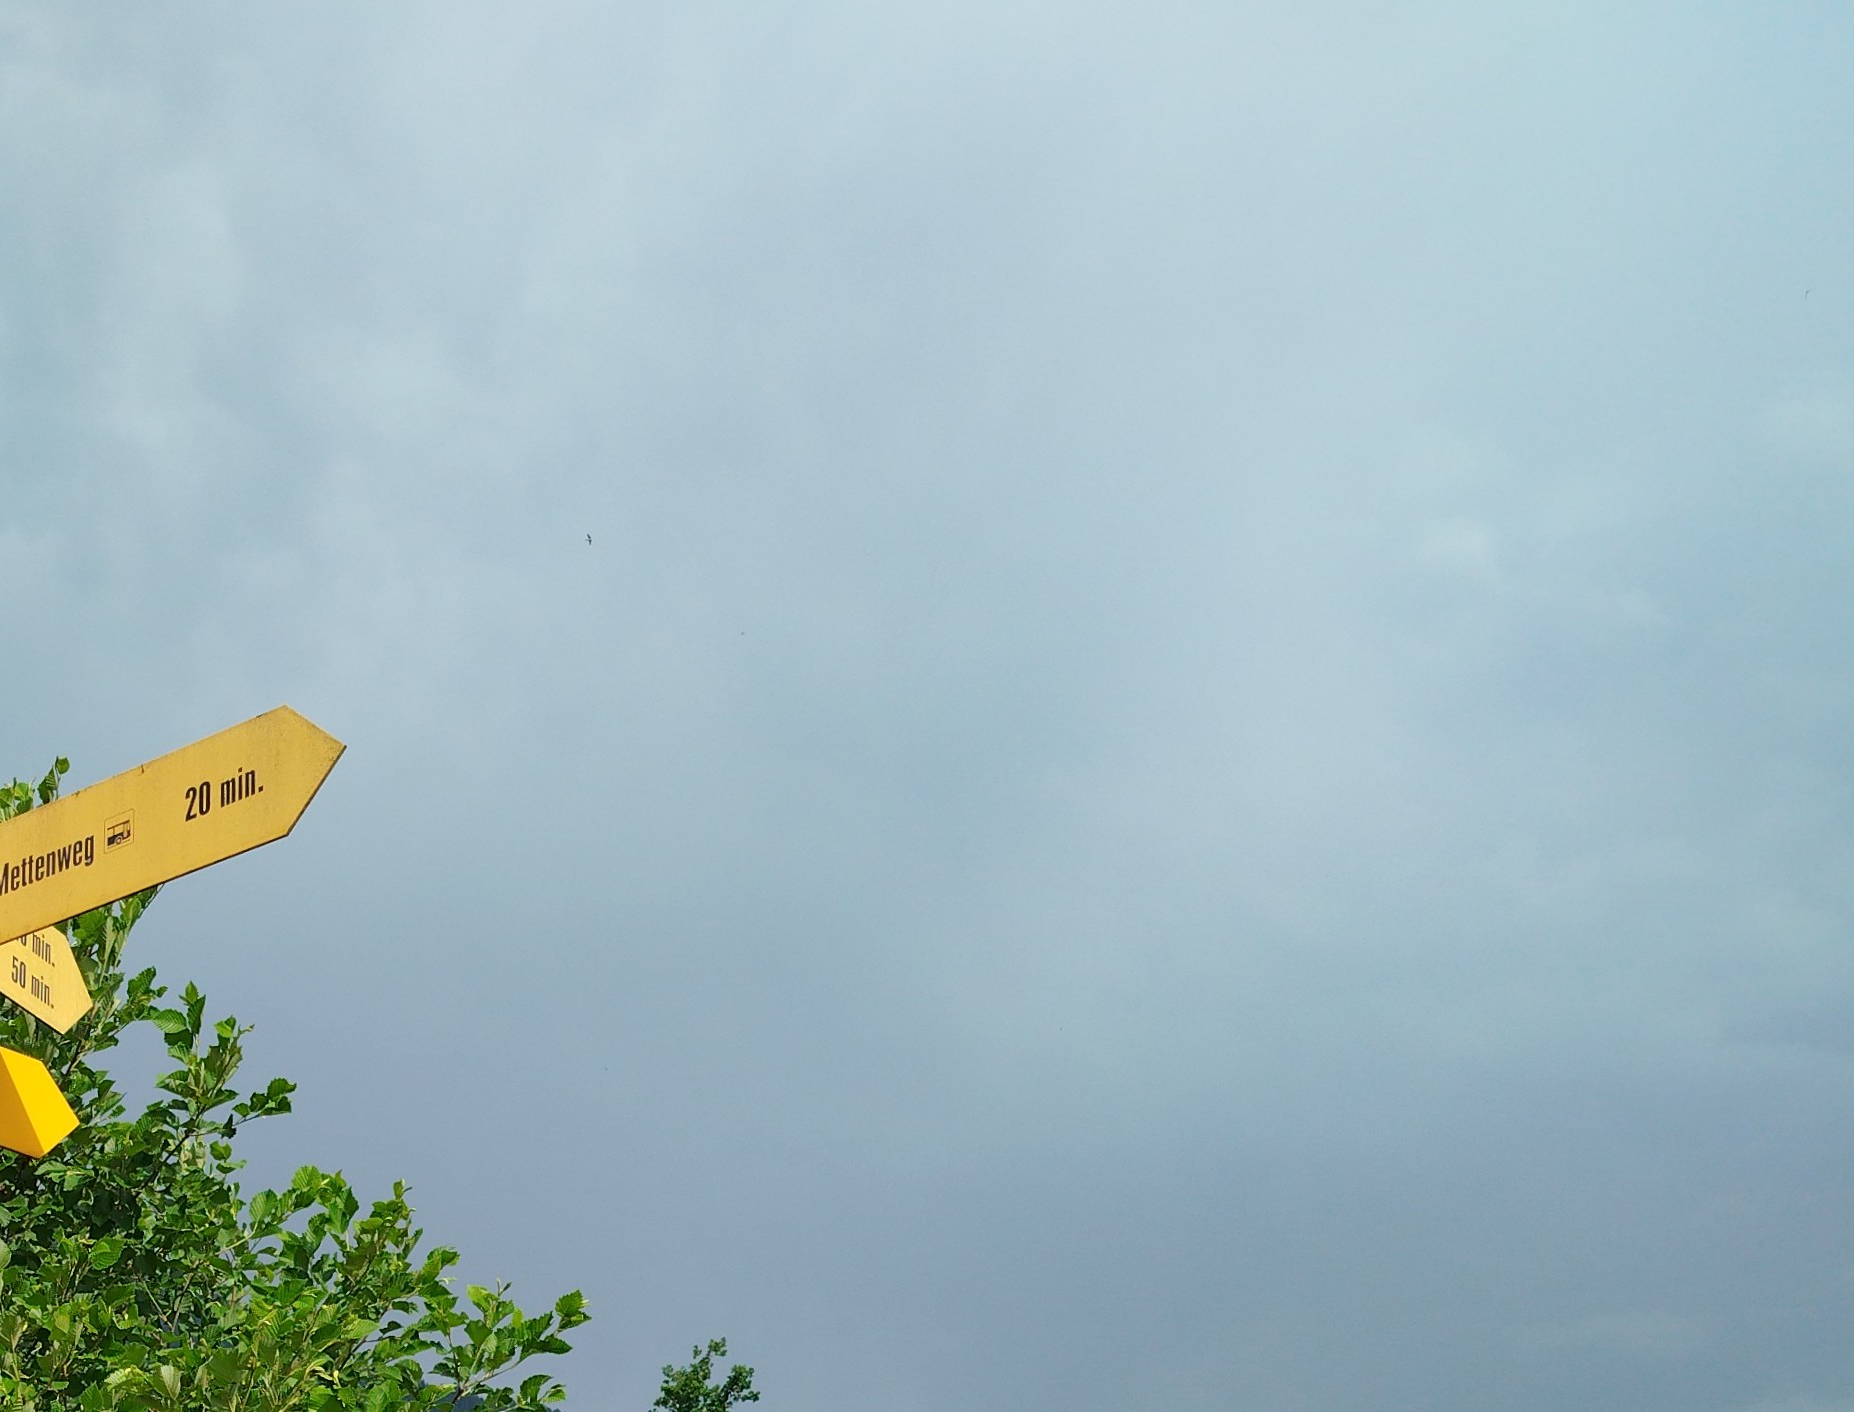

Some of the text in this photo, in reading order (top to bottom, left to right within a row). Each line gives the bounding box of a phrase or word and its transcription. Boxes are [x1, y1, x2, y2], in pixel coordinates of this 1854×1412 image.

[184, 780, 212, 822] 20
[220, 766, 264, 808] min.
[32, 932, 55, 968] min.
[11, 954, 55, 1009] 50 min.
